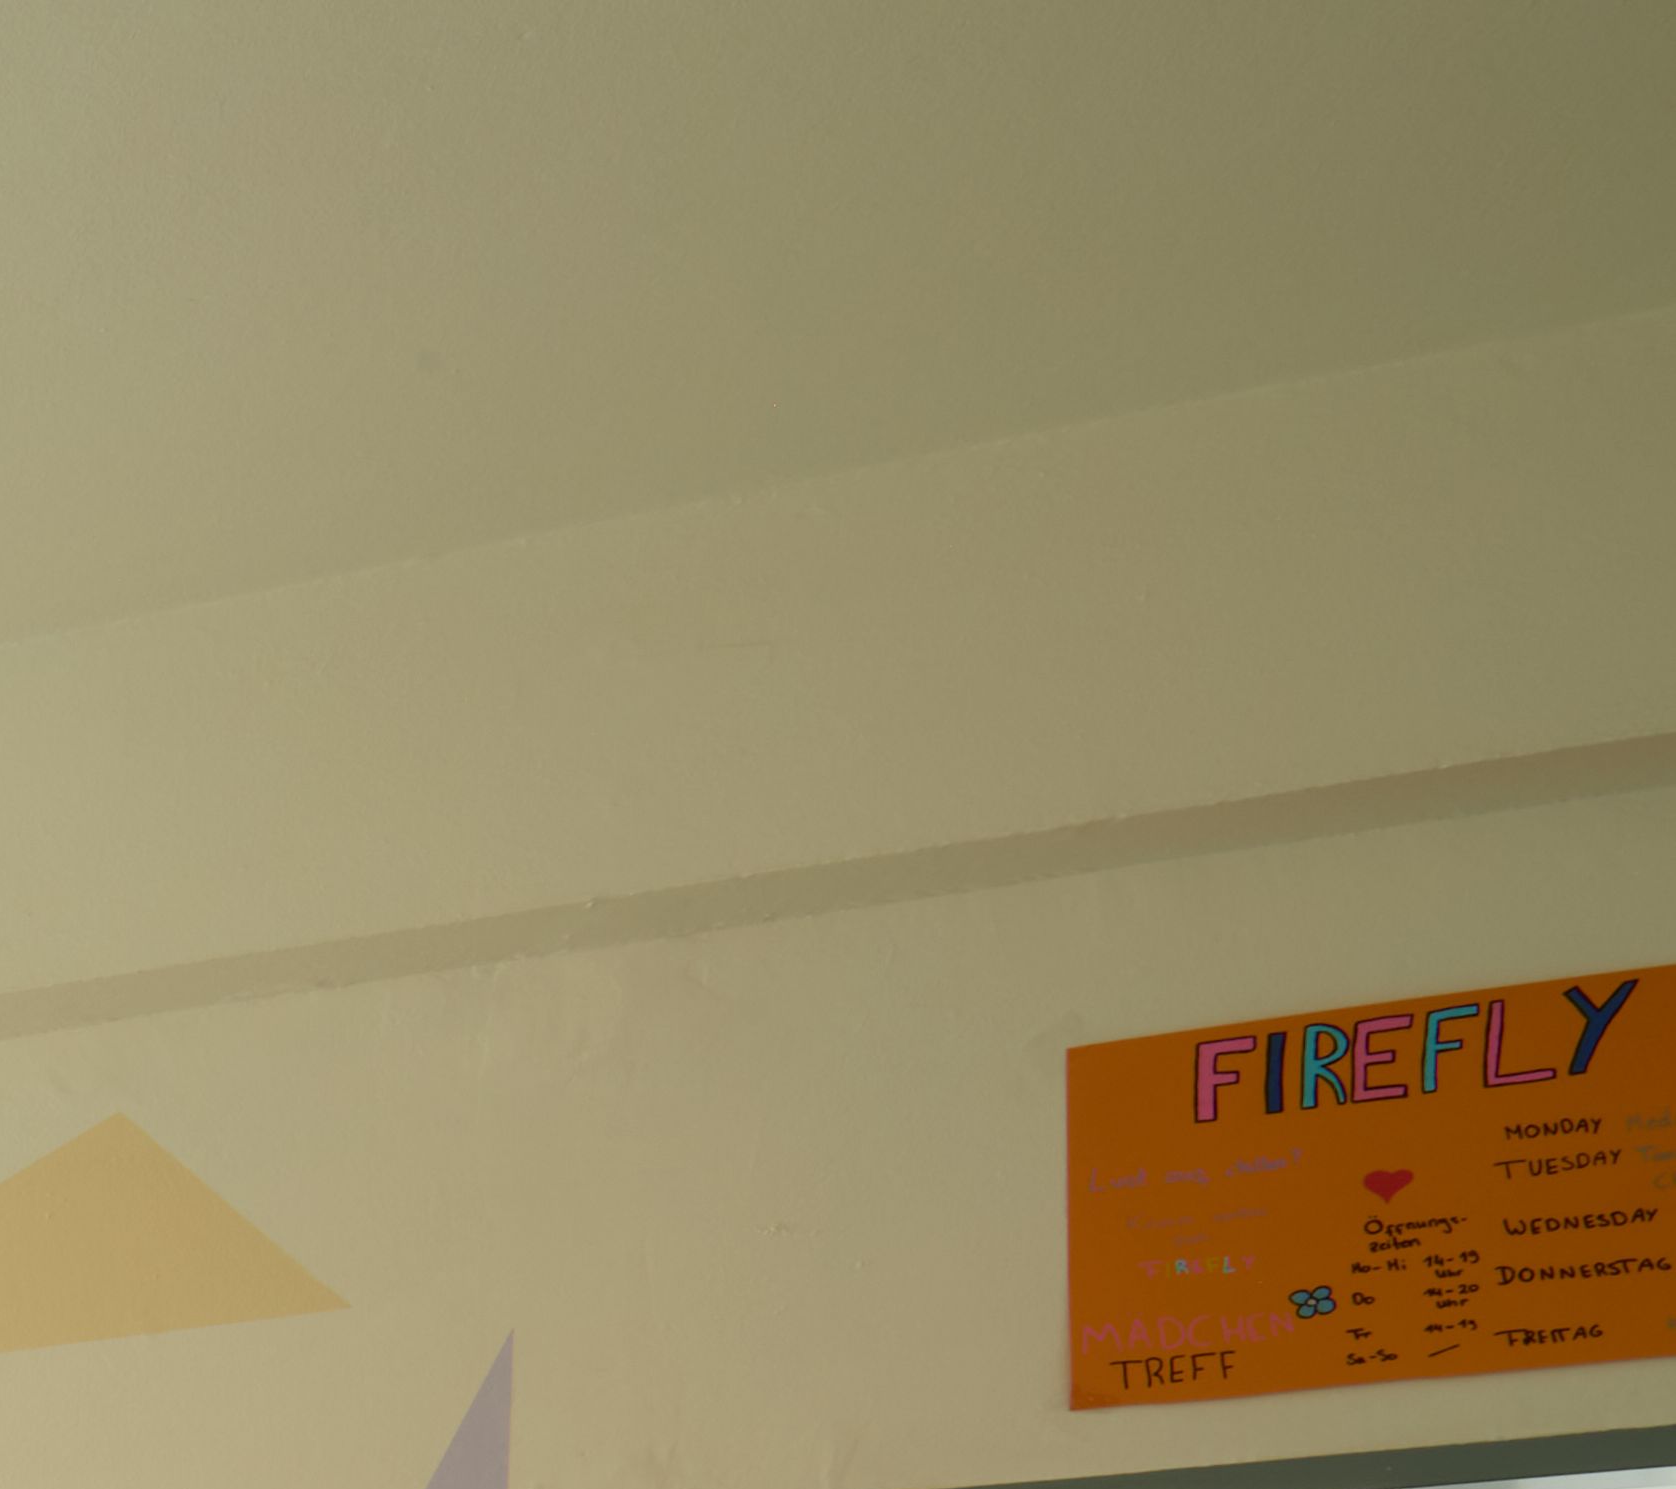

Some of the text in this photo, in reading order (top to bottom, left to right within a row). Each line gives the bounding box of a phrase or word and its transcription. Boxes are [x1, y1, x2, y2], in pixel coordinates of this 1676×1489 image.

[1194, 979, 1640, 1124] FIREFLY
[1504, 1117, 1603, 1141] MONDAY
[1493, 1148, 1623, 1180] TUESDAY
[1502, 1208, 1659, 1237] WEDNESDAY
[1369, 1236, 1422, 1254] zeiten
[1494, 1257, 1673, 1286] DONNERSTAG
[1351, 1291, 1376, 1306] Do
[1345, 1327, 1373, 1341] Fr
[1493, 1324, 1604, 1347] FREITAG
[1109, 1350, 1237, 1390] TREFF
